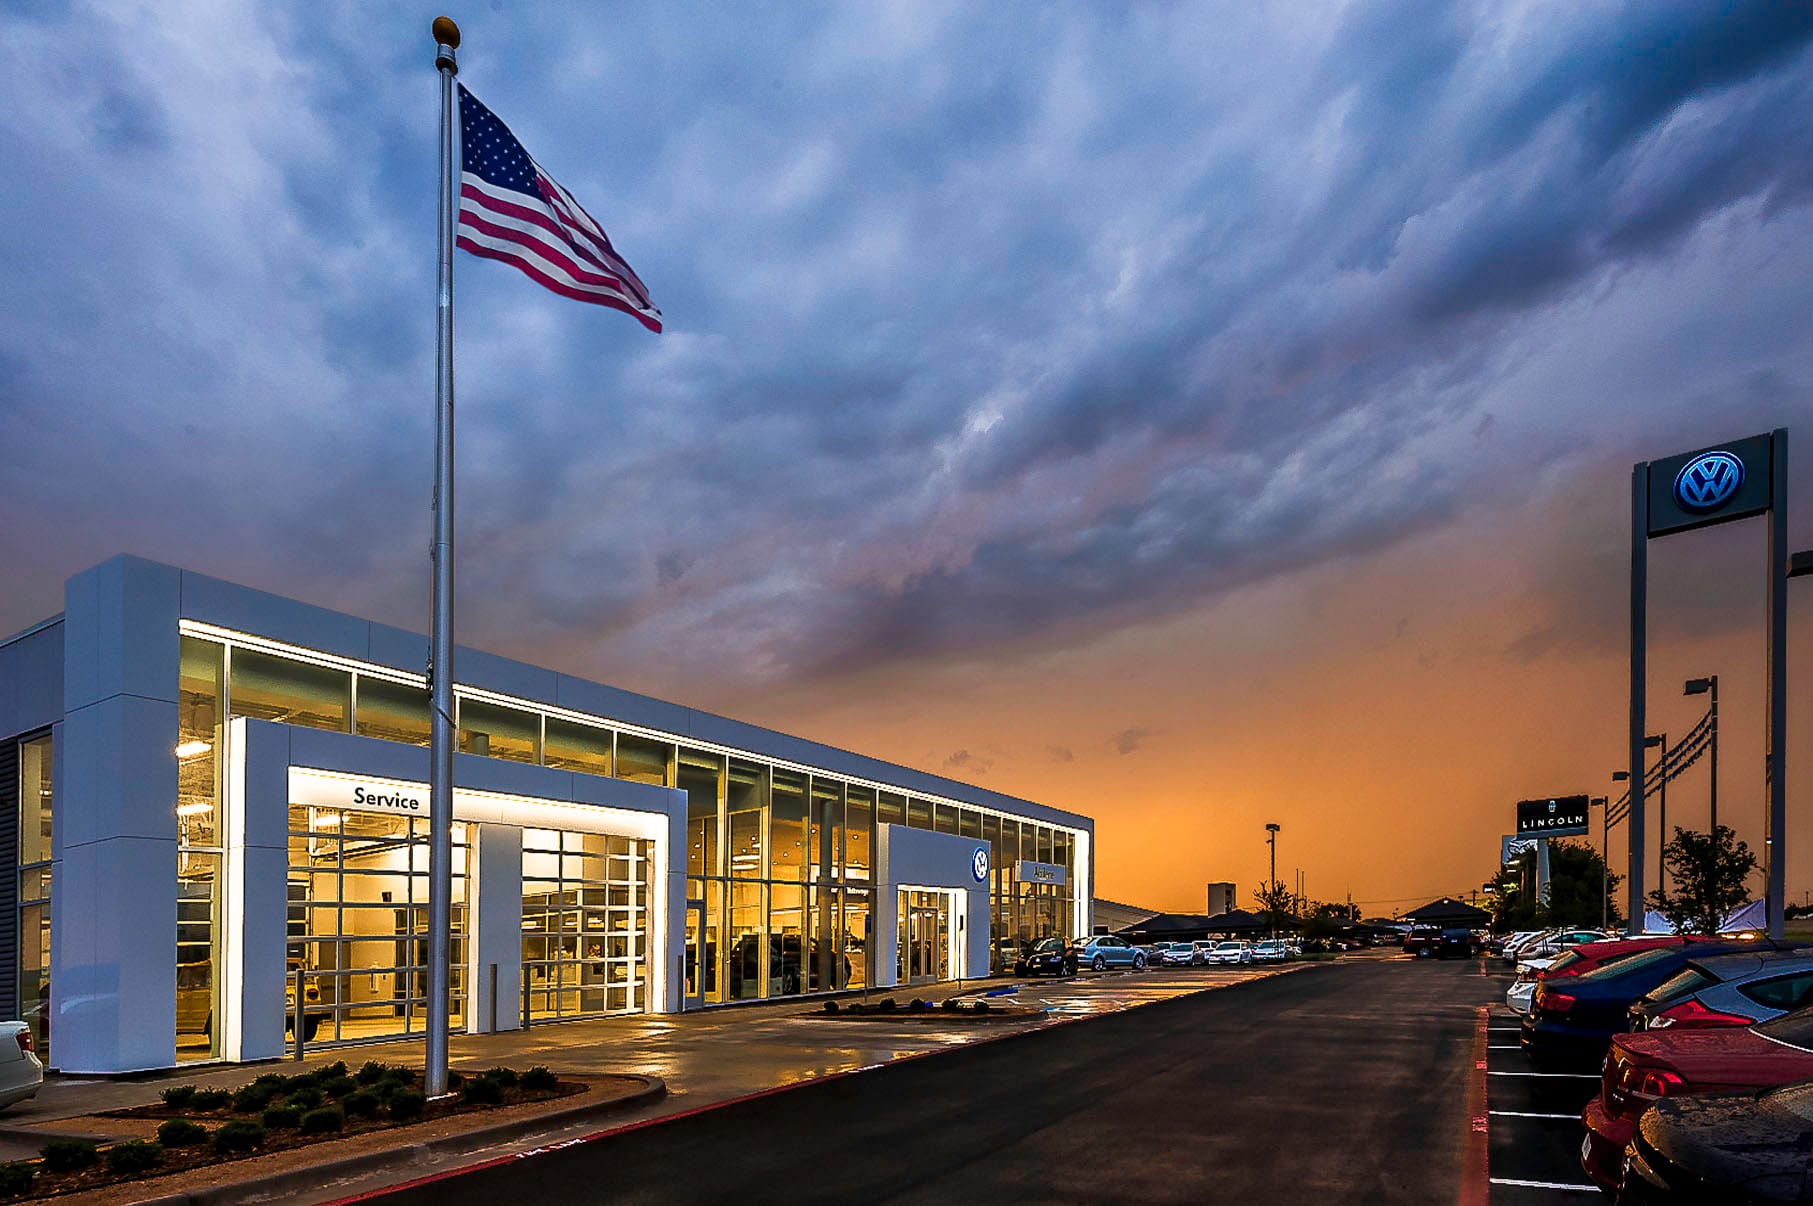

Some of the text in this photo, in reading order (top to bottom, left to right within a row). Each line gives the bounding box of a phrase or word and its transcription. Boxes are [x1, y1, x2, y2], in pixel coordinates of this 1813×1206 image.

[1678, 454, 1741, 509] VW
[353, 786, 419, 810] Service
[1522, 815, 1584, 829] LINCOLN
